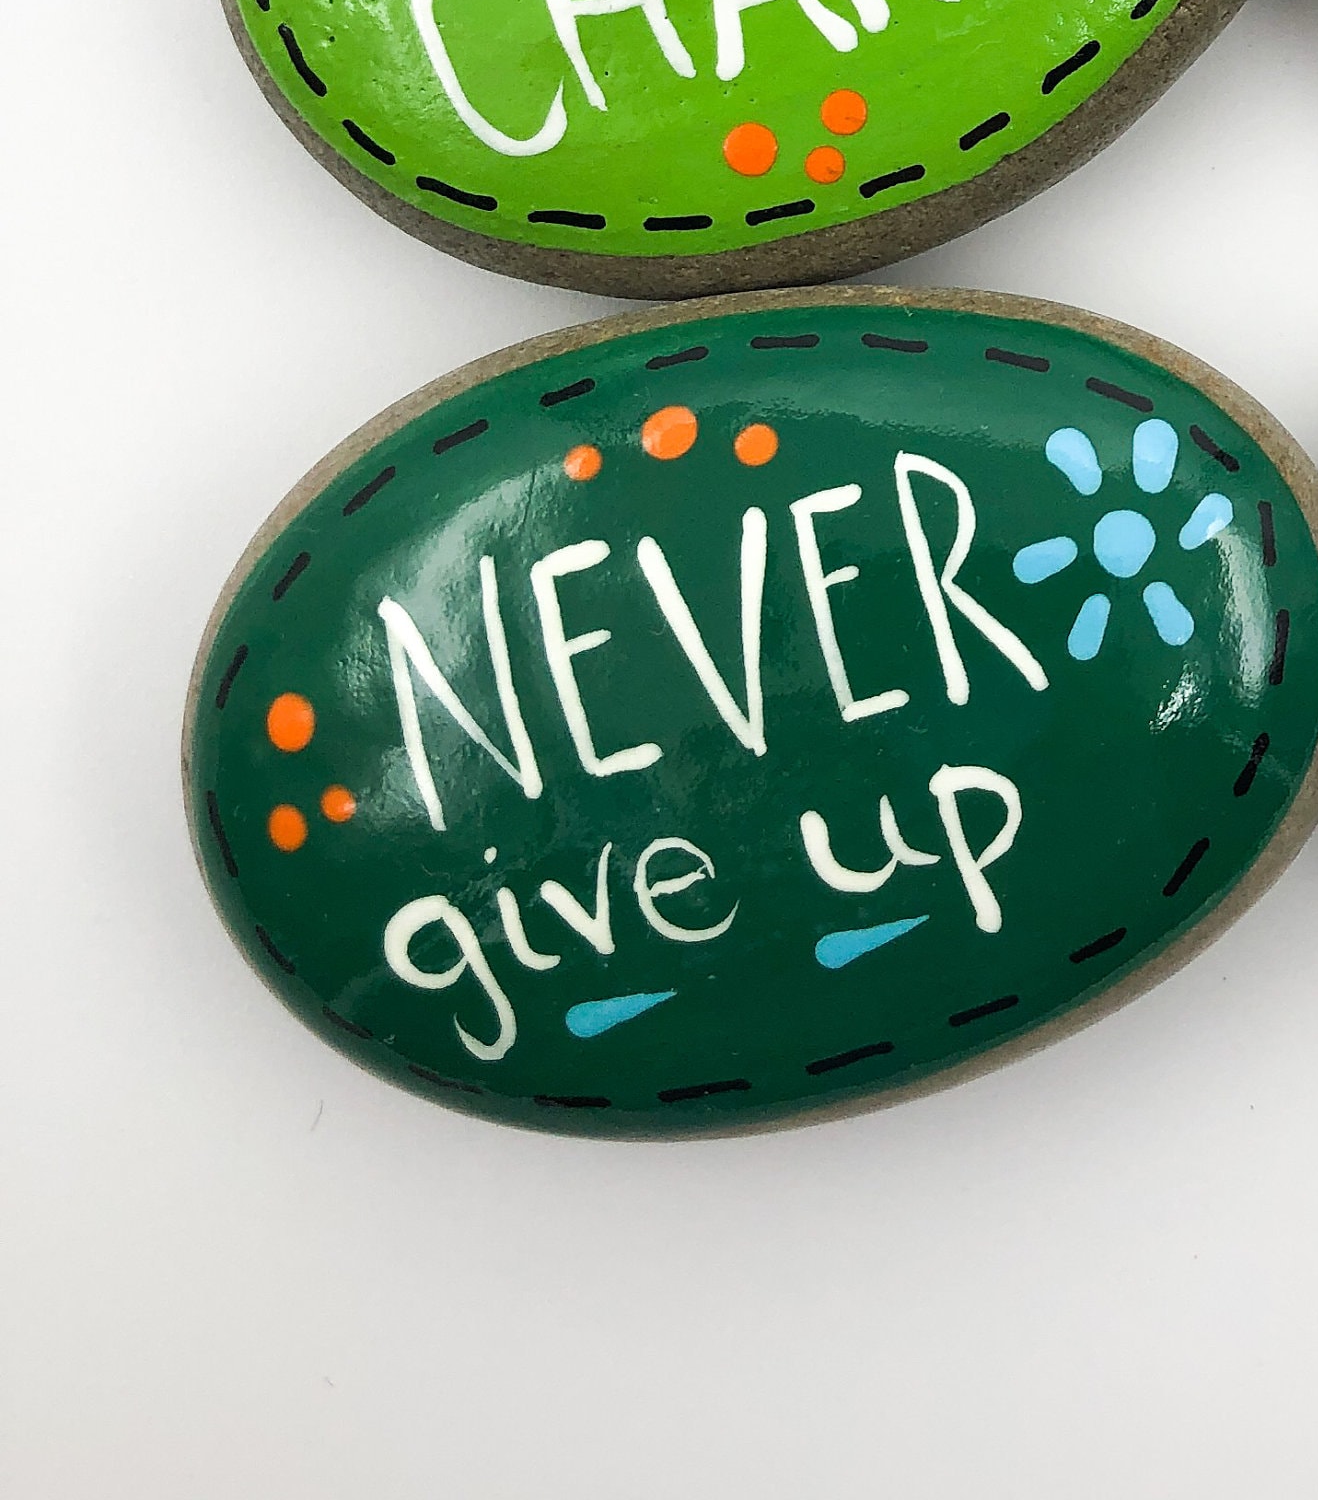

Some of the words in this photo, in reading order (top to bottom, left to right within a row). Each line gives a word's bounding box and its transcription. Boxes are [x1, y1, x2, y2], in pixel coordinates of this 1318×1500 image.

[378, 450, 1049, 832] NEVER
[382, 835, 743, 1062] give
[800, 762, 1023, 936] up
